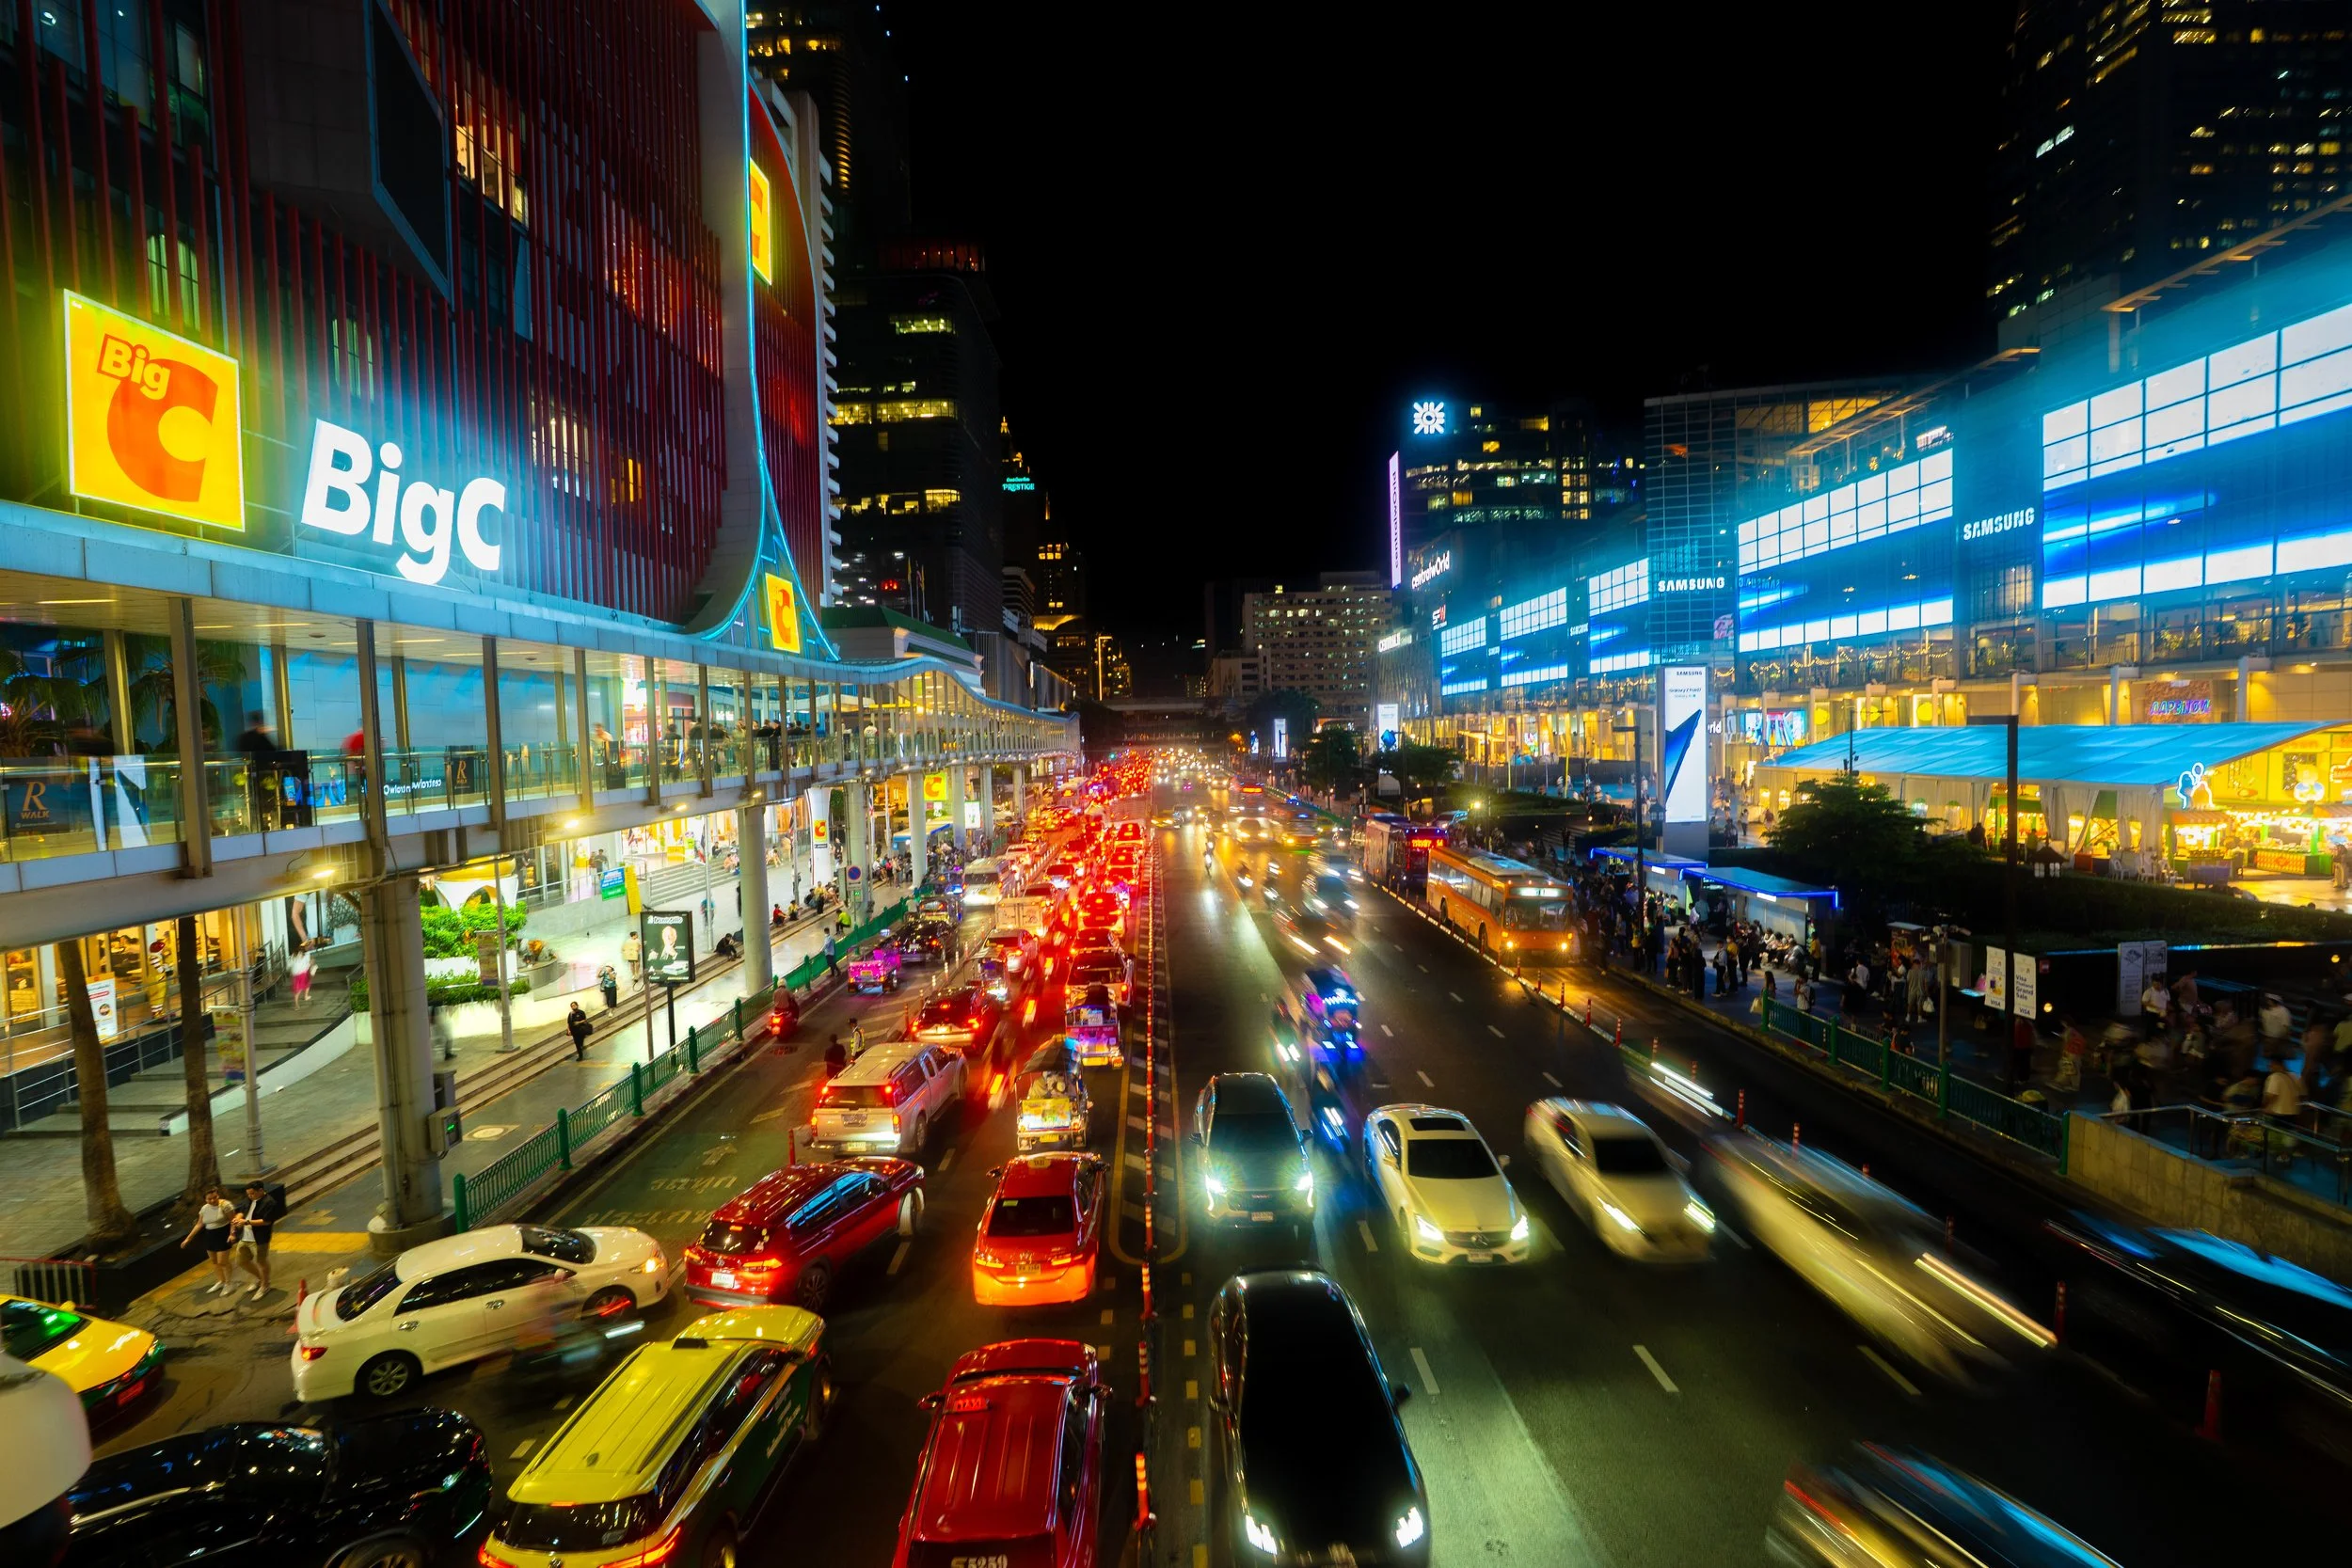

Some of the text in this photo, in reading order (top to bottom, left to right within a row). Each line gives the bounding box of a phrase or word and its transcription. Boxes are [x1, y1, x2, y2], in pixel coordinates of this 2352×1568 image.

[98, 334, 171, 401] Big
[1963, 507, 2035, 541] SAMSUNG
[1658, 577, 1725, 593] SAMSUNG
[22, 782, 49, 811] R
[21, 810, 50, 819] WALK
[2019, 1007, 2030, 1016] VISA
